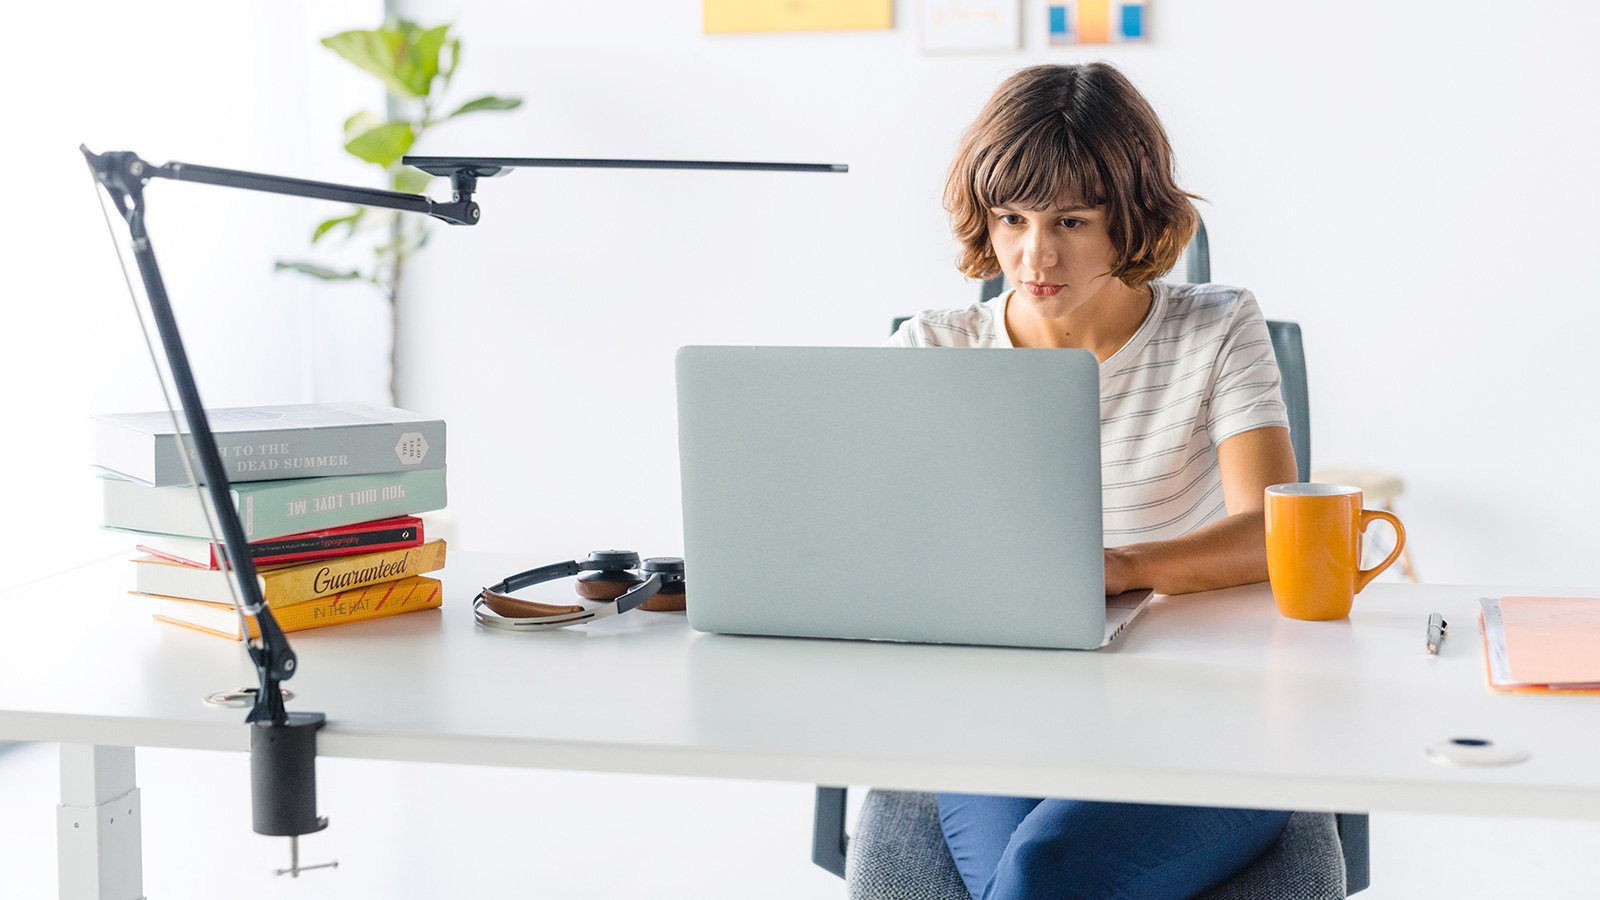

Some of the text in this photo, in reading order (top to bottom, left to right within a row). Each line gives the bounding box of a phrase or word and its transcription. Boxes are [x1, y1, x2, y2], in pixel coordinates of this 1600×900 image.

[186, 443, 289, 460] RH TO THE
[237, 455, 349, 472] DEAD SUMMER
[287, 484, 405, 517] YOU WILL LOVE ME
[320, 536, 360, 548] typography
[313, 551, 409, 594] Guaranteed
[314, 607, 326, 619] IN
[328, 602, 346, 616] THE
[348, 598, 371, 613] HAT
